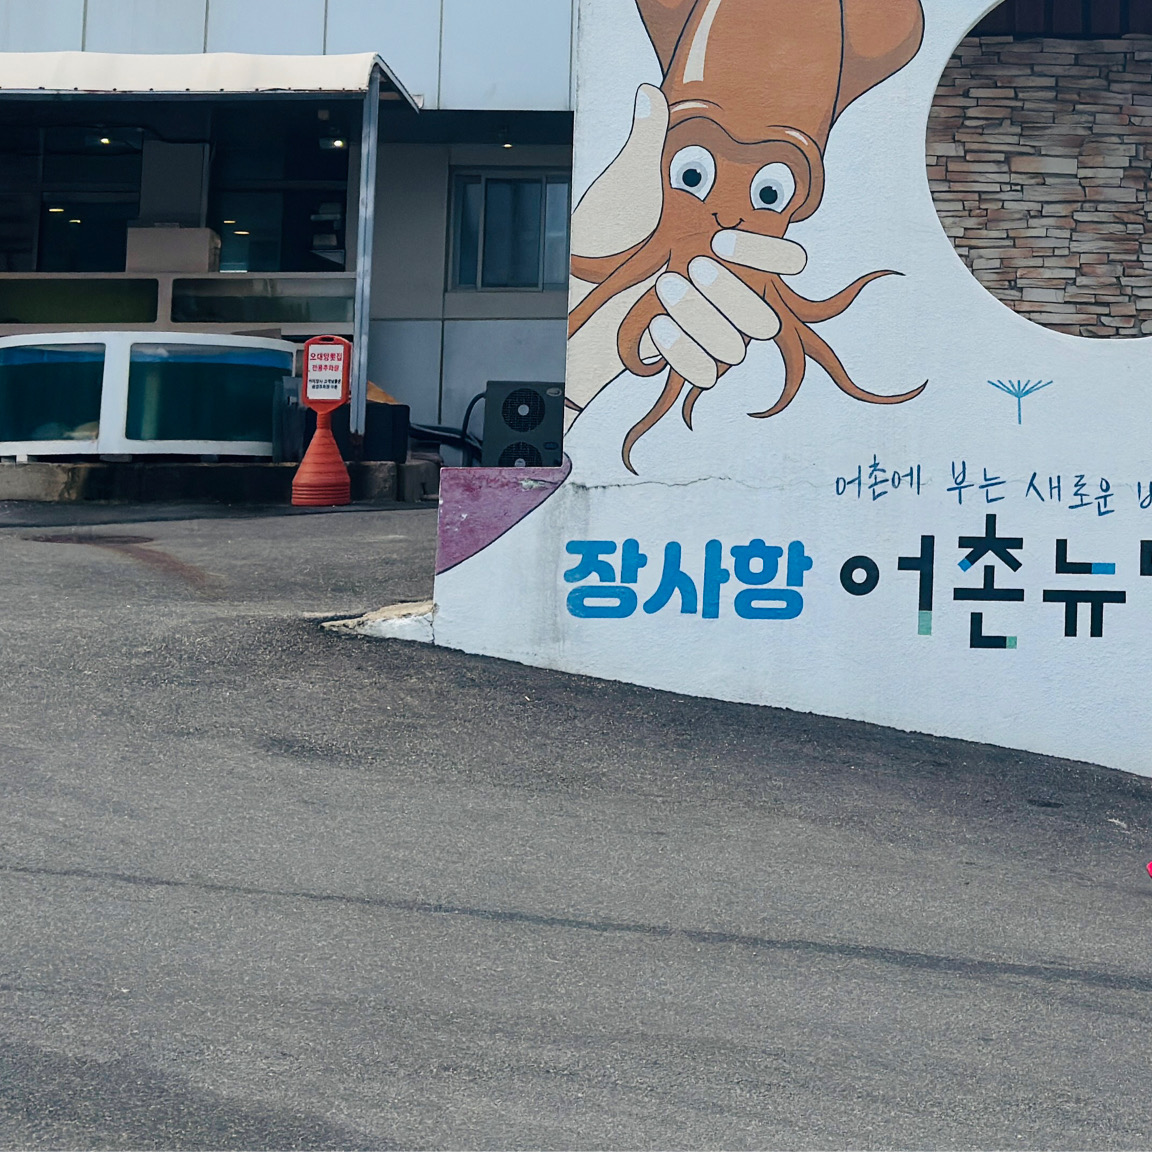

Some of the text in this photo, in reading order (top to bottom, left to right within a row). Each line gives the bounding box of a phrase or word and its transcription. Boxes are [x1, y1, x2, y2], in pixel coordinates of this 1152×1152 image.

[835, 454, 922, 501] 어촌에
[946, 461, 1007, 504] 부는
[1025, 472, 1116, 517] 새로운
[563, 538, 813, 619] 장사항
